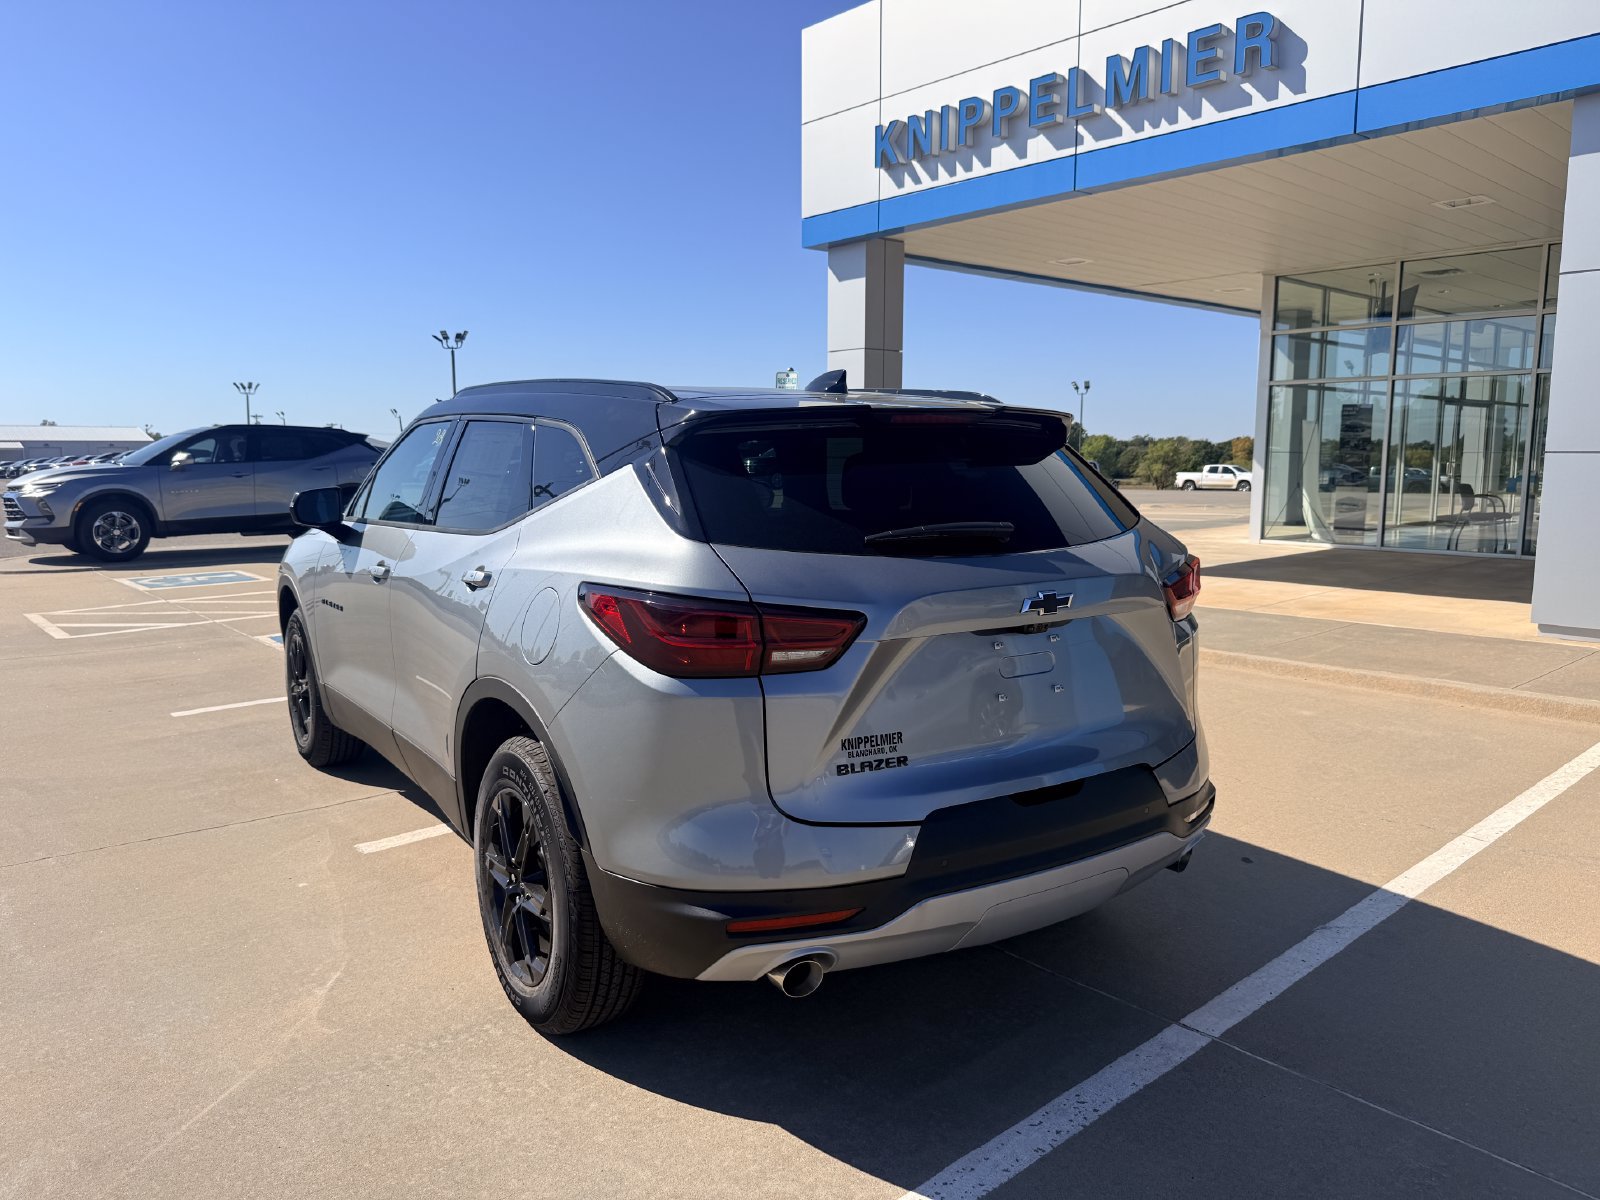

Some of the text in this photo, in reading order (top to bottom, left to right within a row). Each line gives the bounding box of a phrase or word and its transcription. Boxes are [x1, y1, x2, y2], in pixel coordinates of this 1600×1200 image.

[875, 11, 1279, 169] KNIPPELMIER
[841, 731, 903, 751] KNIPPELMIER
[889, 745, 898, 753] OK
[836, 755, 909, 776] BLAZER
